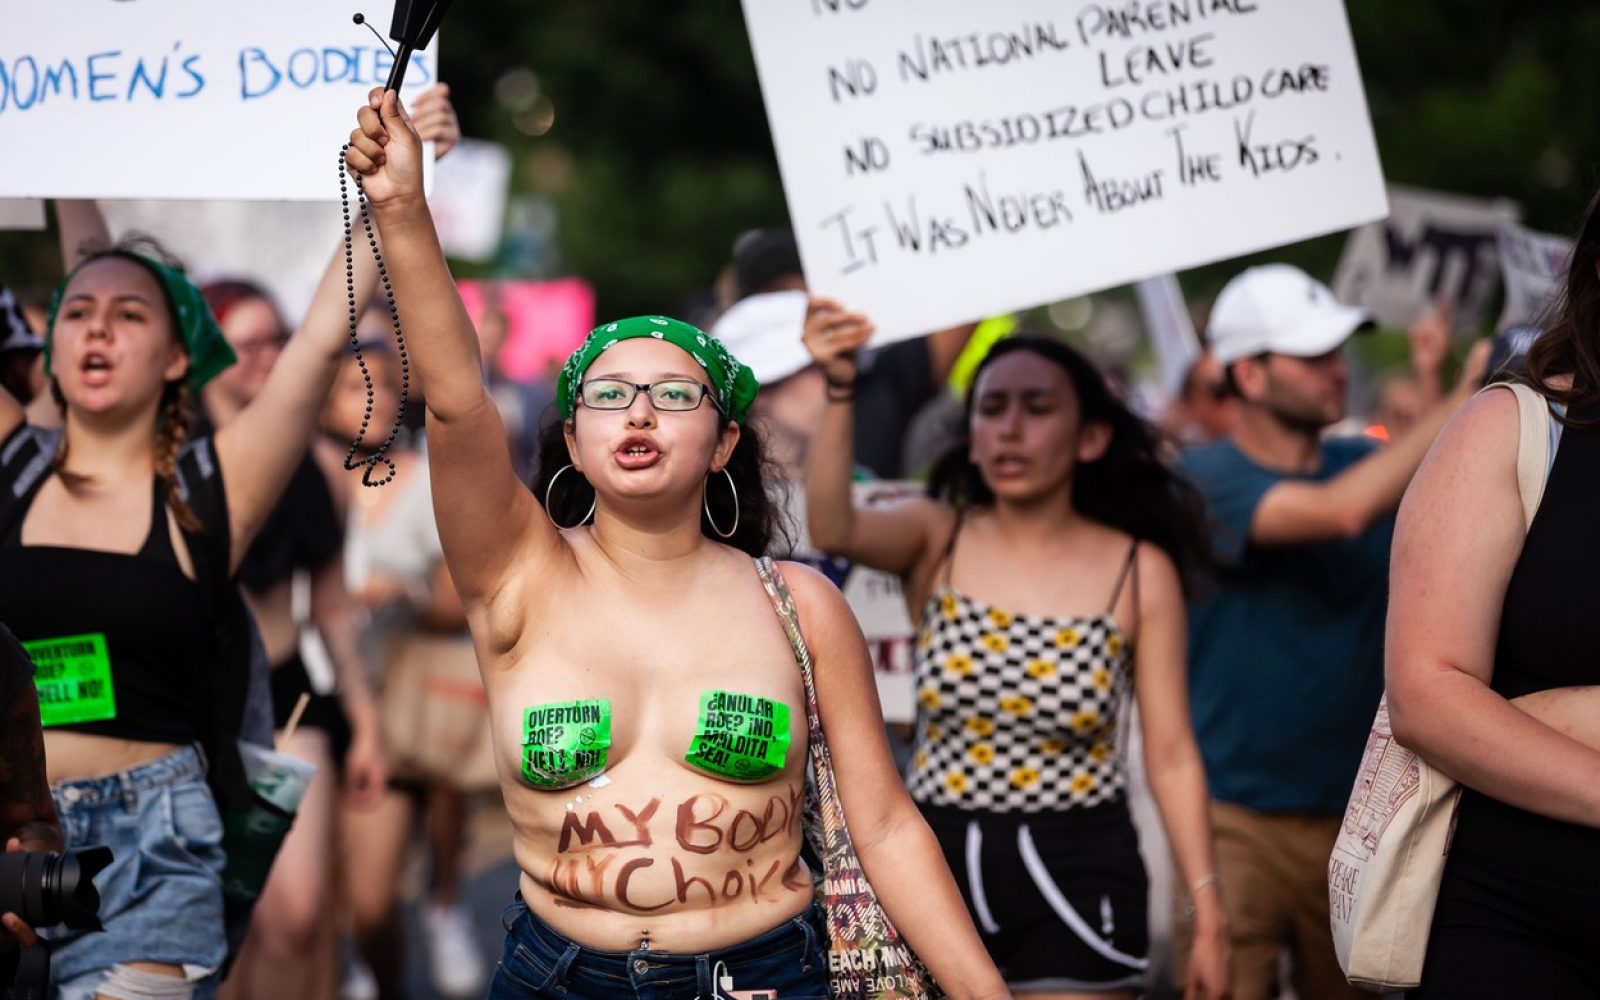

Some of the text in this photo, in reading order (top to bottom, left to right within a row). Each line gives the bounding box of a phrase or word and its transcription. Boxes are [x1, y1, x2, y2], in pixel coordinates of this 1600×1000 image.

[0, 40, 430, 116] OMEN'S BODIES
[827, 57, 878, 103] NO
[897, 21, 1069, 82] NATIONAL
[1099, 32, 1215, 87] LEAVE
[844, 136, 890, 176] NO
[527, 725, 565, 746] ROE?
[528, 705, 600, 729] OVERTURN
[705, 711, 745, 732] ROE?
[557, 797, 661, 854] MY
